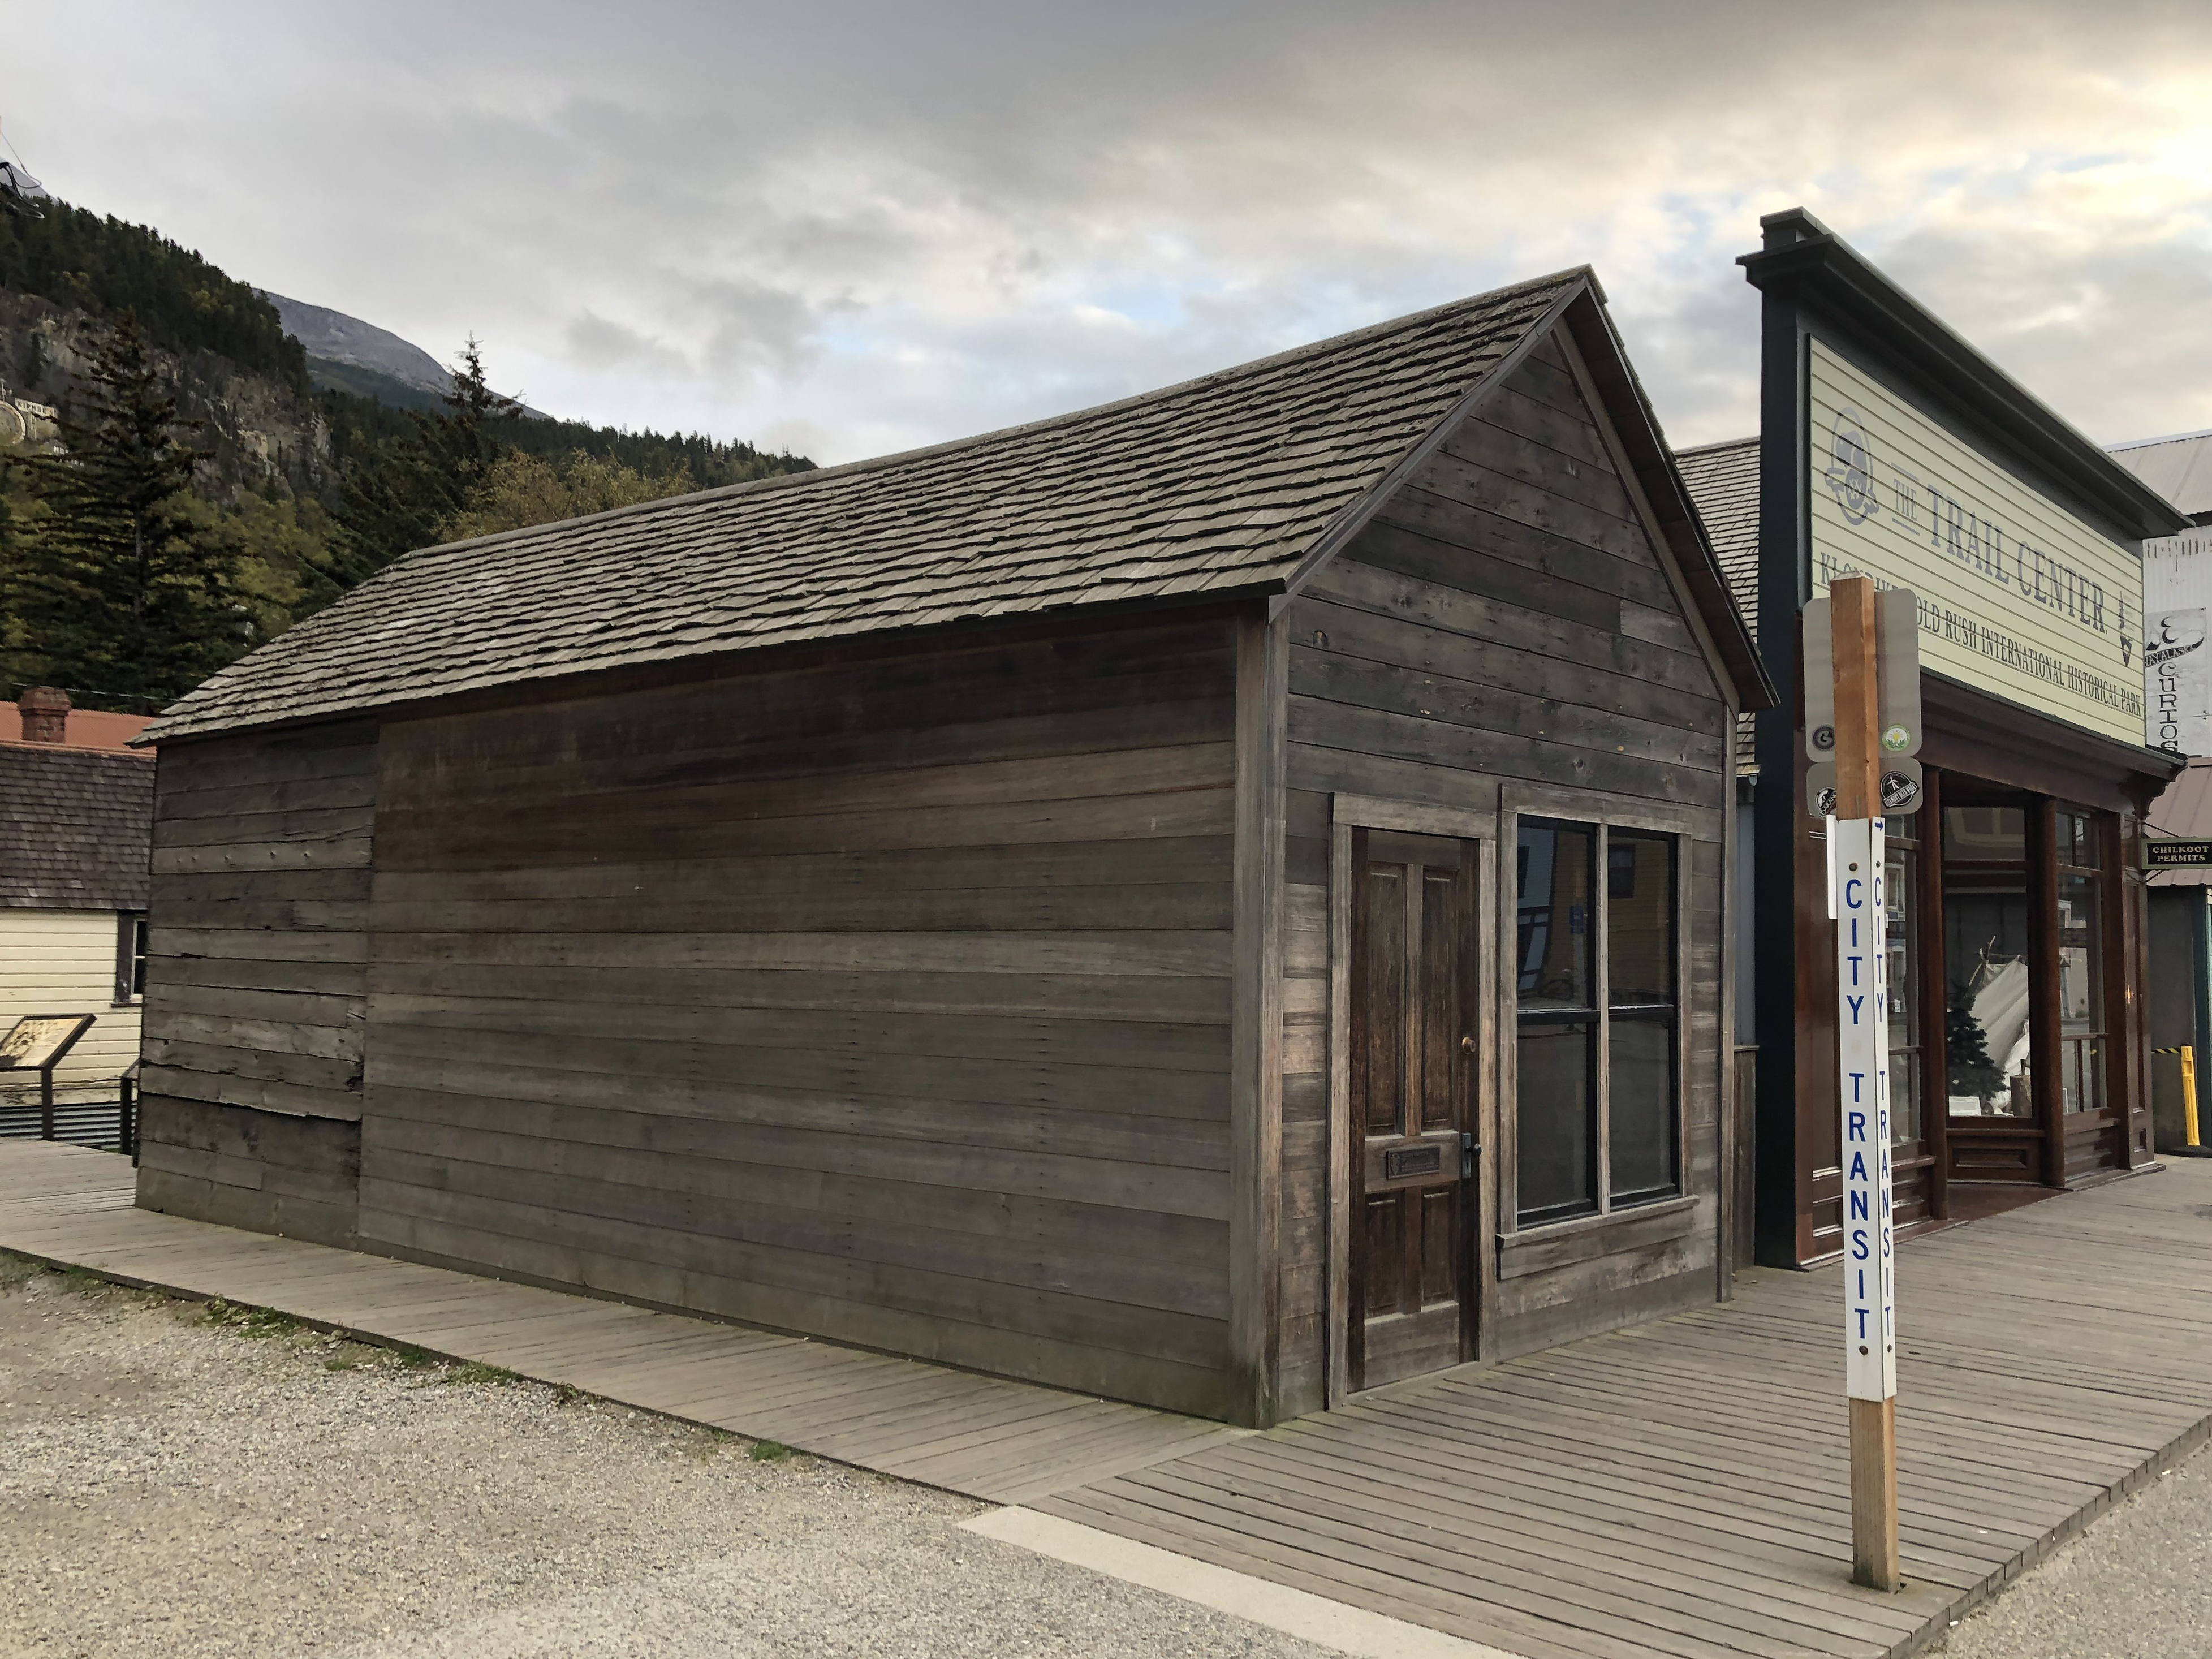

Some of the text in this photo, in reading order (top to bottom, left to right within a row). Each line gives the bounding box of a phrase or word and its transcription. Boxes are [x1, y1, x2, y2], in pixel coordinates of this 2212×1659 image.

[1893, 478, 1917, 521] THE
[1927, 483, 2010, 585] TRAIL
[1916, 596, 2142, 717] OLD RUSH INTERNATIONAL HISTORICAL PARK
[2158, 662, 2178, 753] CURIOS
[1846, 878, 1870, 1339] CITY TRANSIT
[1874, 876, 1891, 1337] CITY TRANSIT
